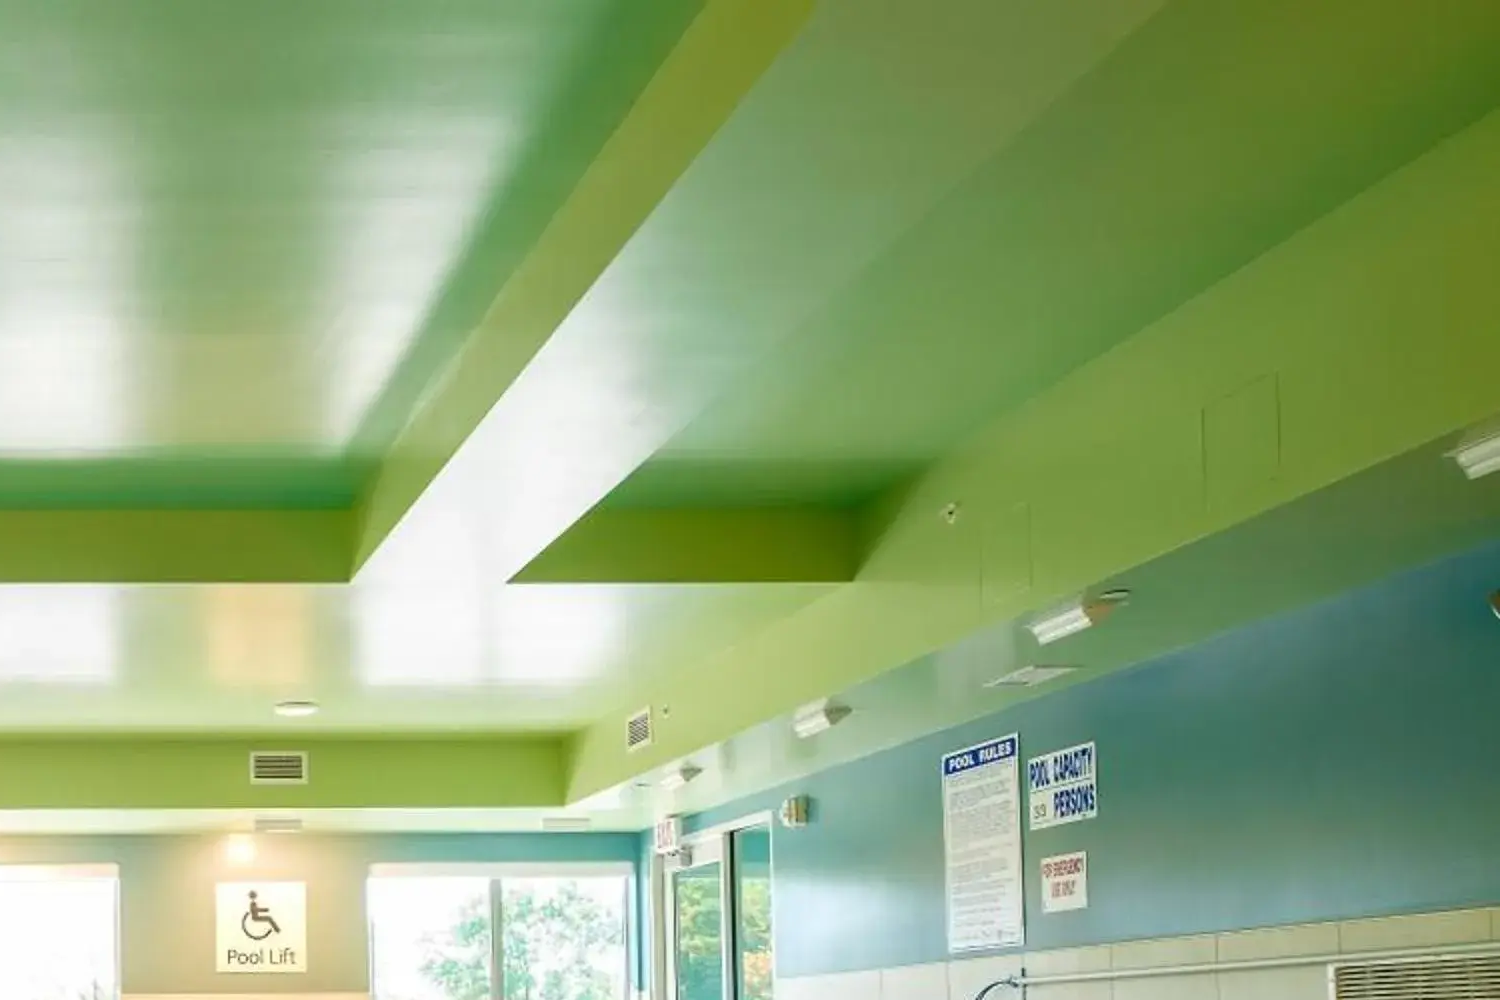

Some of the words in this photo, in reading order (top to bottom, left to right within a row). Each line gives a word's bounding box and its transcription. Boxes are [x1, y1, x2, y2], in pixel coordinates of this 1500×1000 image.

[948, 753, 975, 773] POOL
[979, 741, 1013, 763] RULES
[1029, 760, 1051, 790] POOL
[1053, 745, 1093, 783] CAPACITY
[1053, 783, 1095, 819] PERSONS
[227, 948, 264, 965] Pool
[269, 947, 297, 965] Lift
